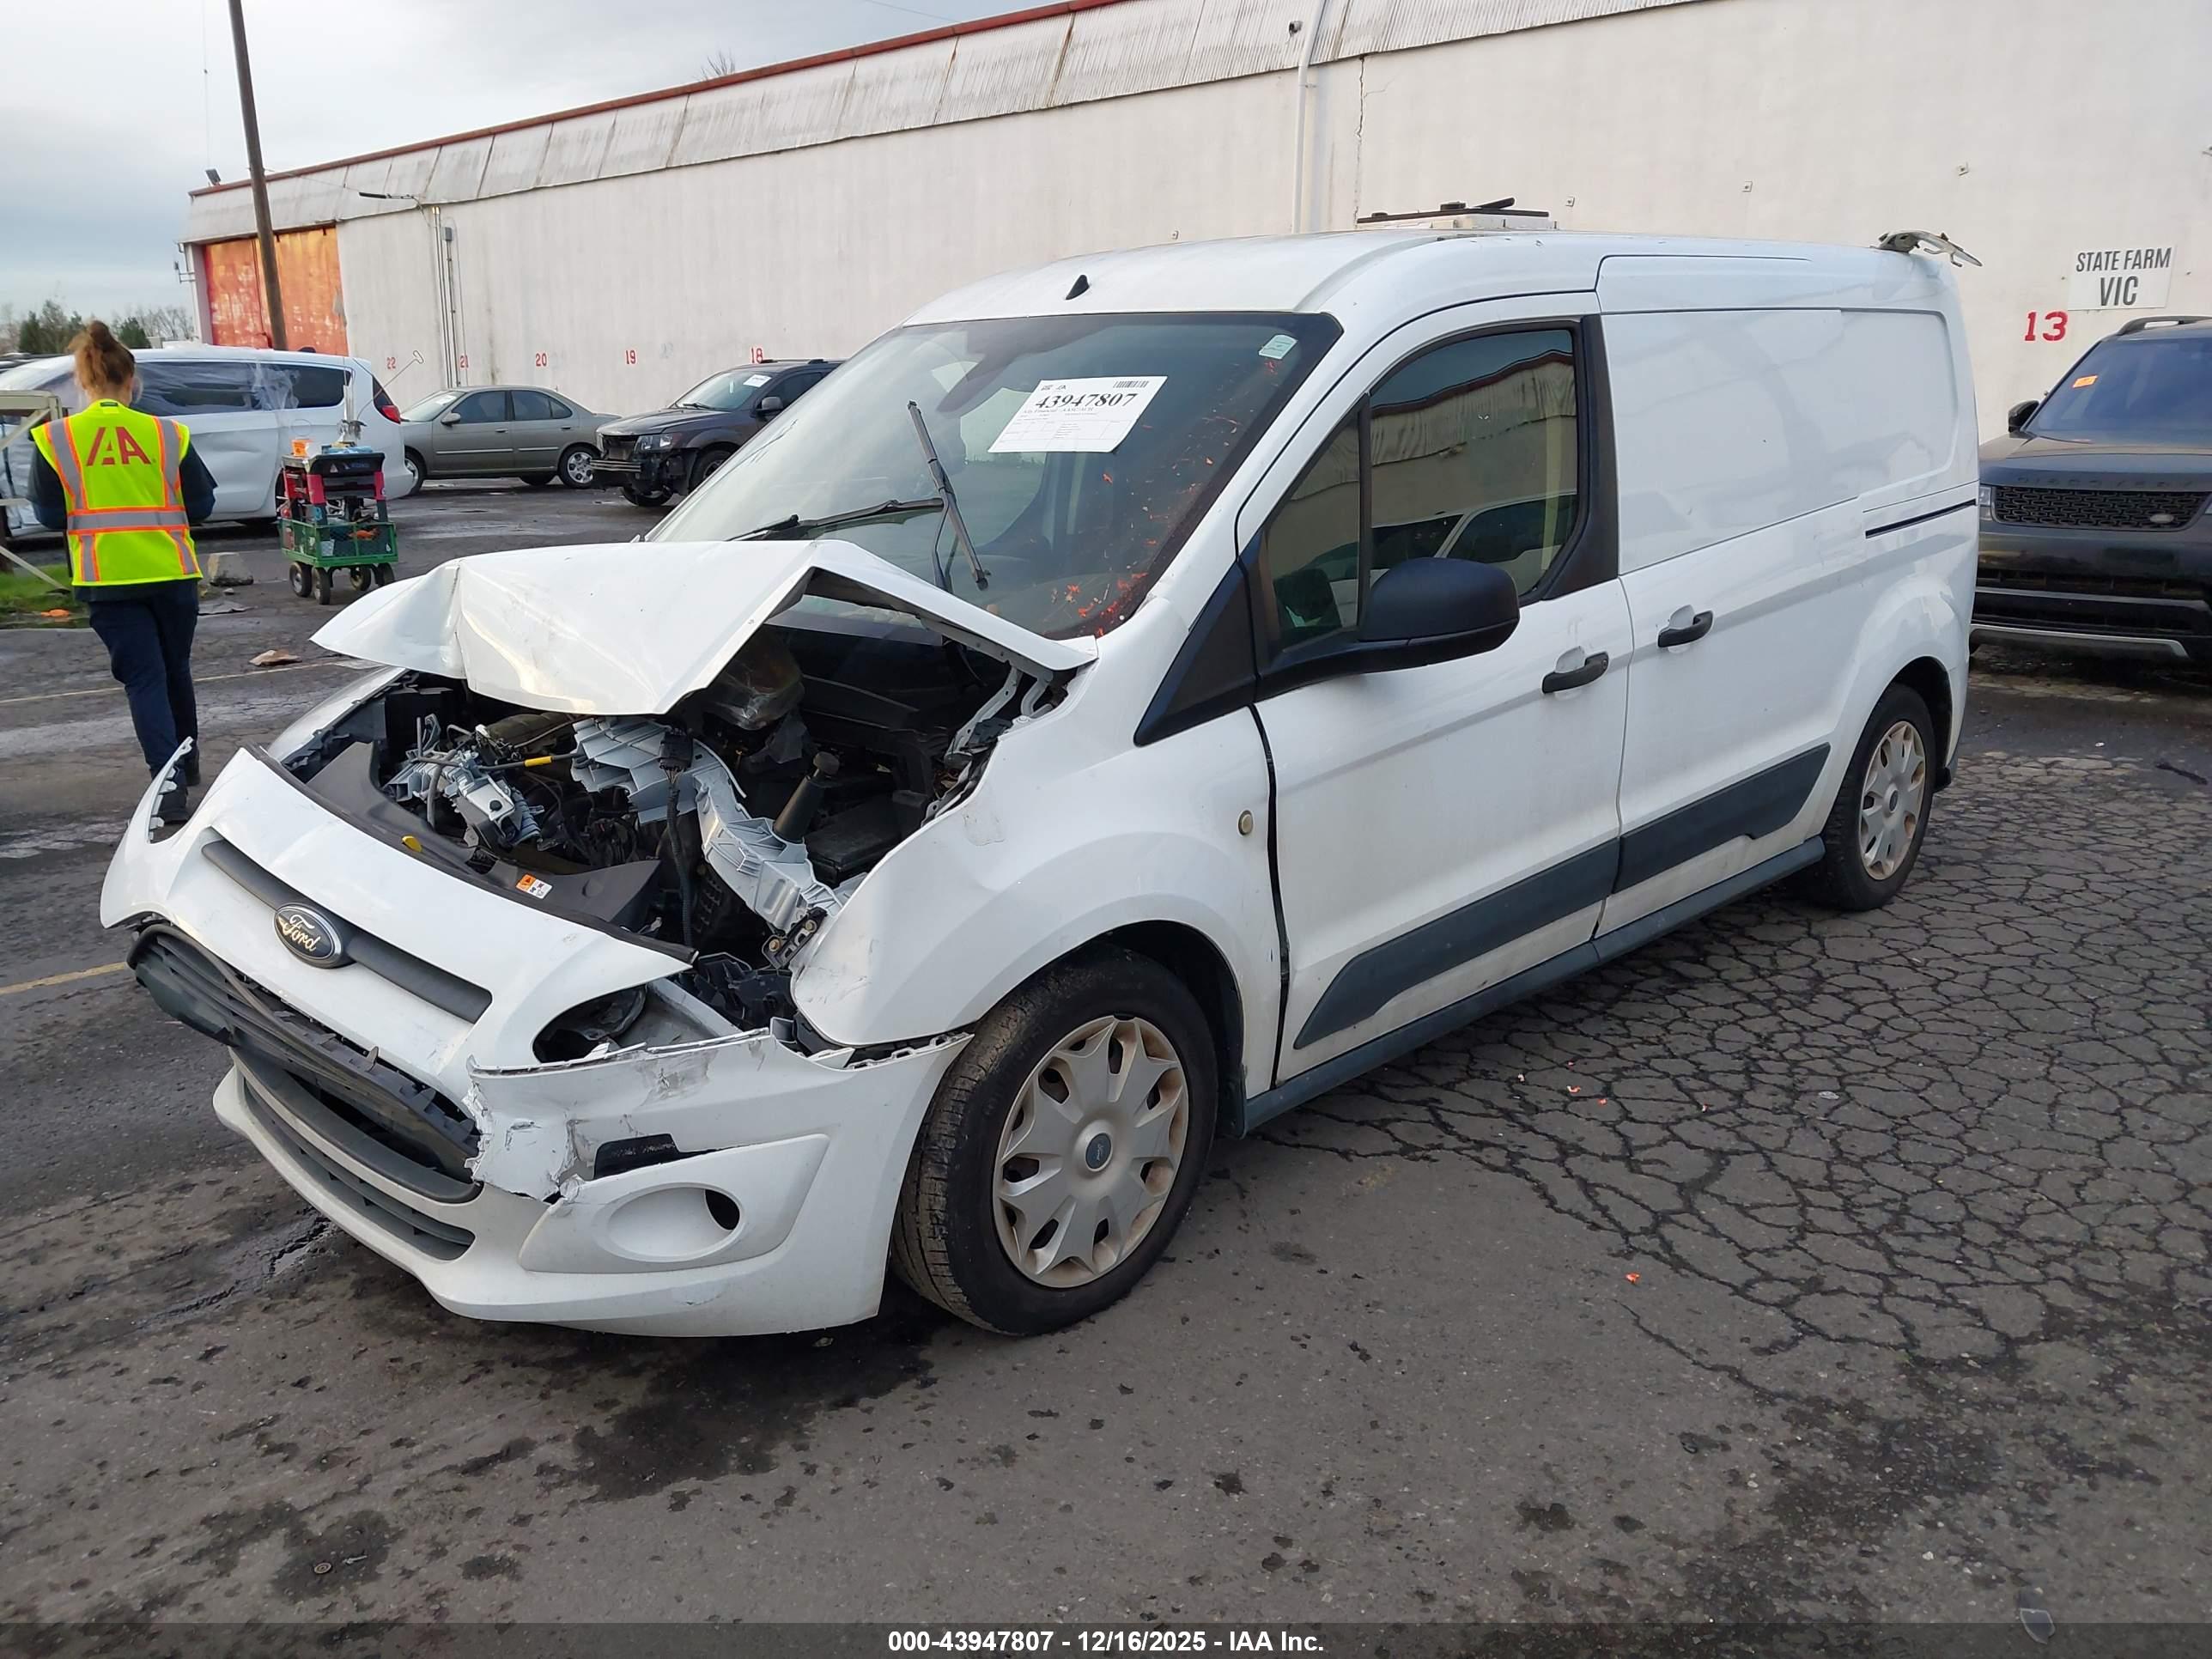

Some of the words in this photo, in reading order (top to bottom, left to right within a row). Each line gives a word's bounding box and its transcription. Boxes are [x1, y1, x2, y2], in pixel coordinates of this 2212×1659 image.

[2075, 251, 2120, 272] STATE
[2124, 246, 2172, 270] FARM
[2100, 276, 2139, 307] VIC
[2025, 311, 2069, 342] 13
[386, 356, 397, 369] 22
[535, 353, 548, 367] 20
[625, 349, 636, 364] 19
[750, 347, 763, 364] 18
[1035, 392, 1138, 409] 43947807
[277, 914, 321, 951] Ford
